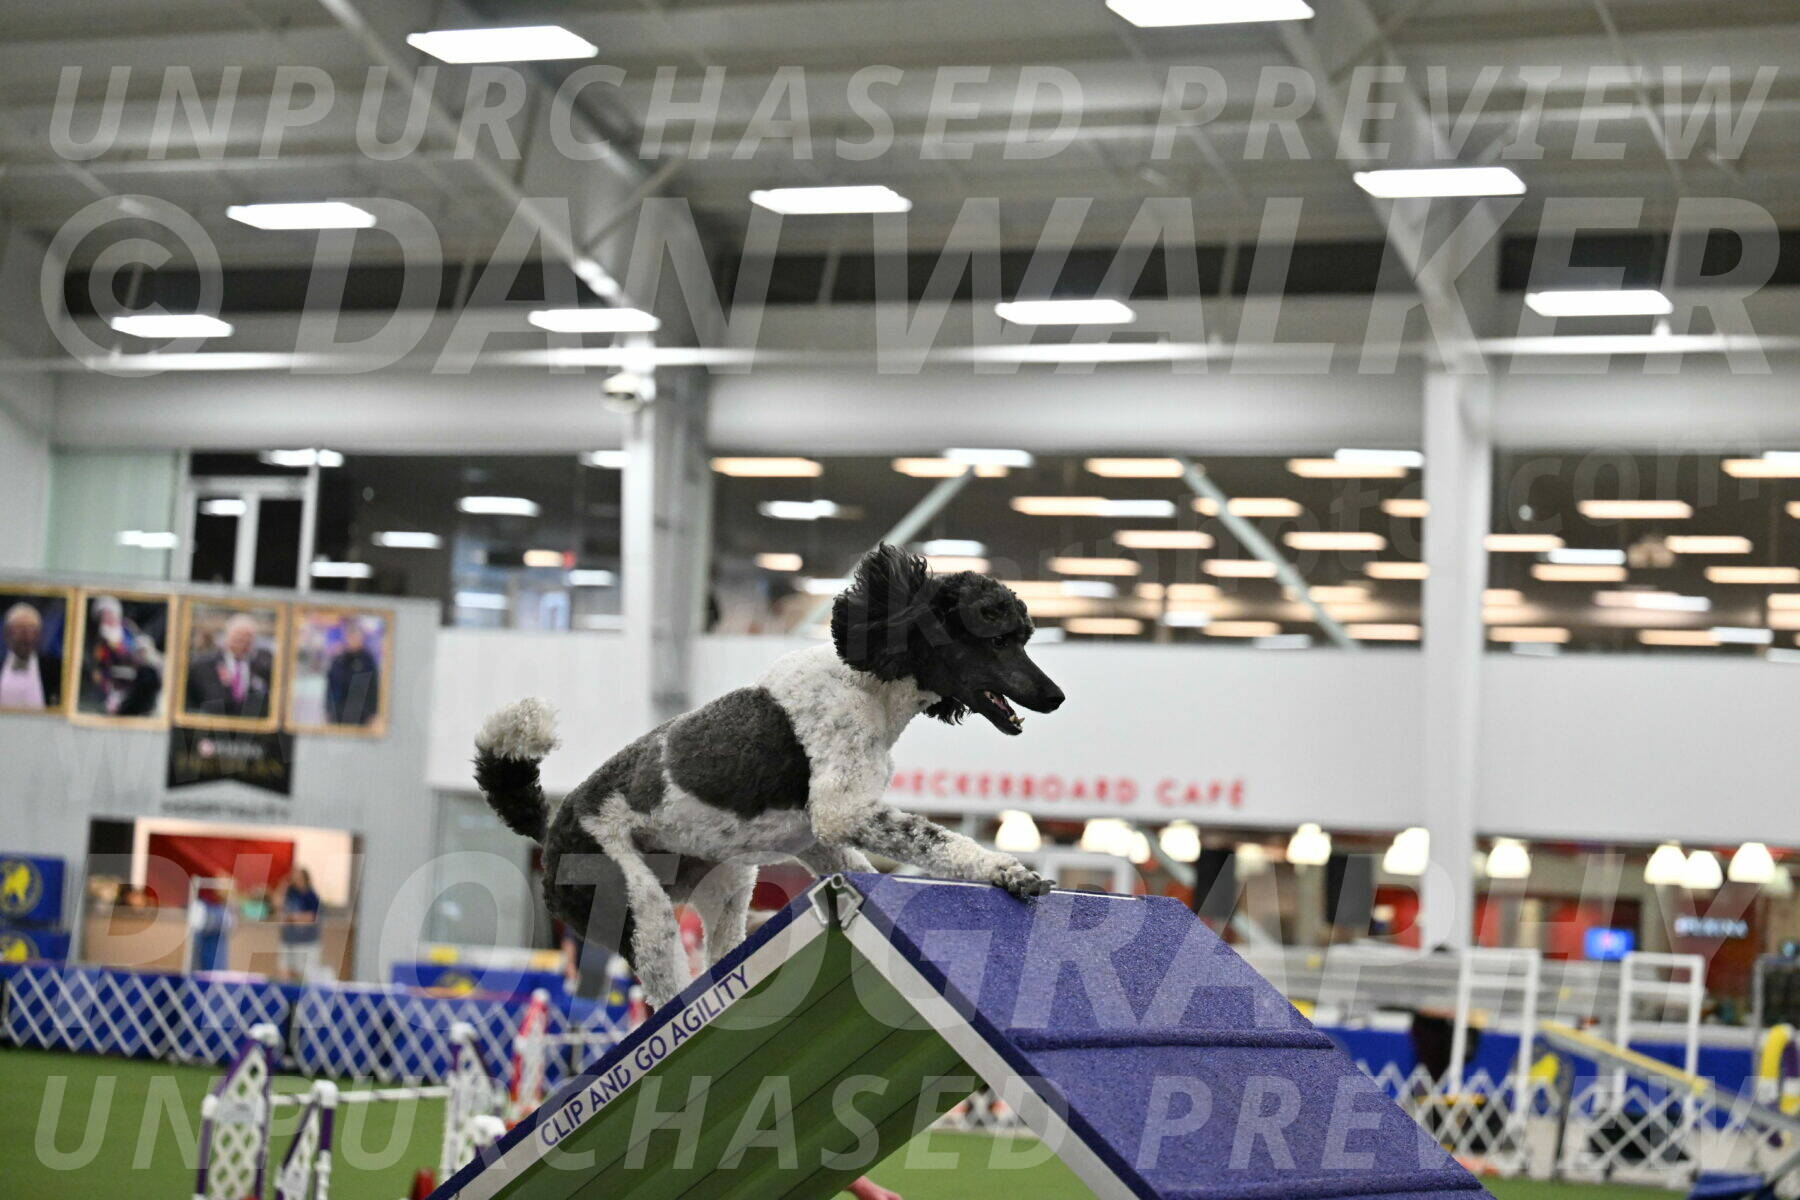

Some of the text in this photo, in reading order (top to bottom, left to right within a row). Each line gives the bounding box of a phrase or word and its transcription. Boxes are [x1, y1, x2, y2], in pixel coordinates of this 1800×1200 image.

[889, 769, 1139, 804] HECKERBOARD
[540, 965, 749, 1146] CLIP AND GO AGILITY
